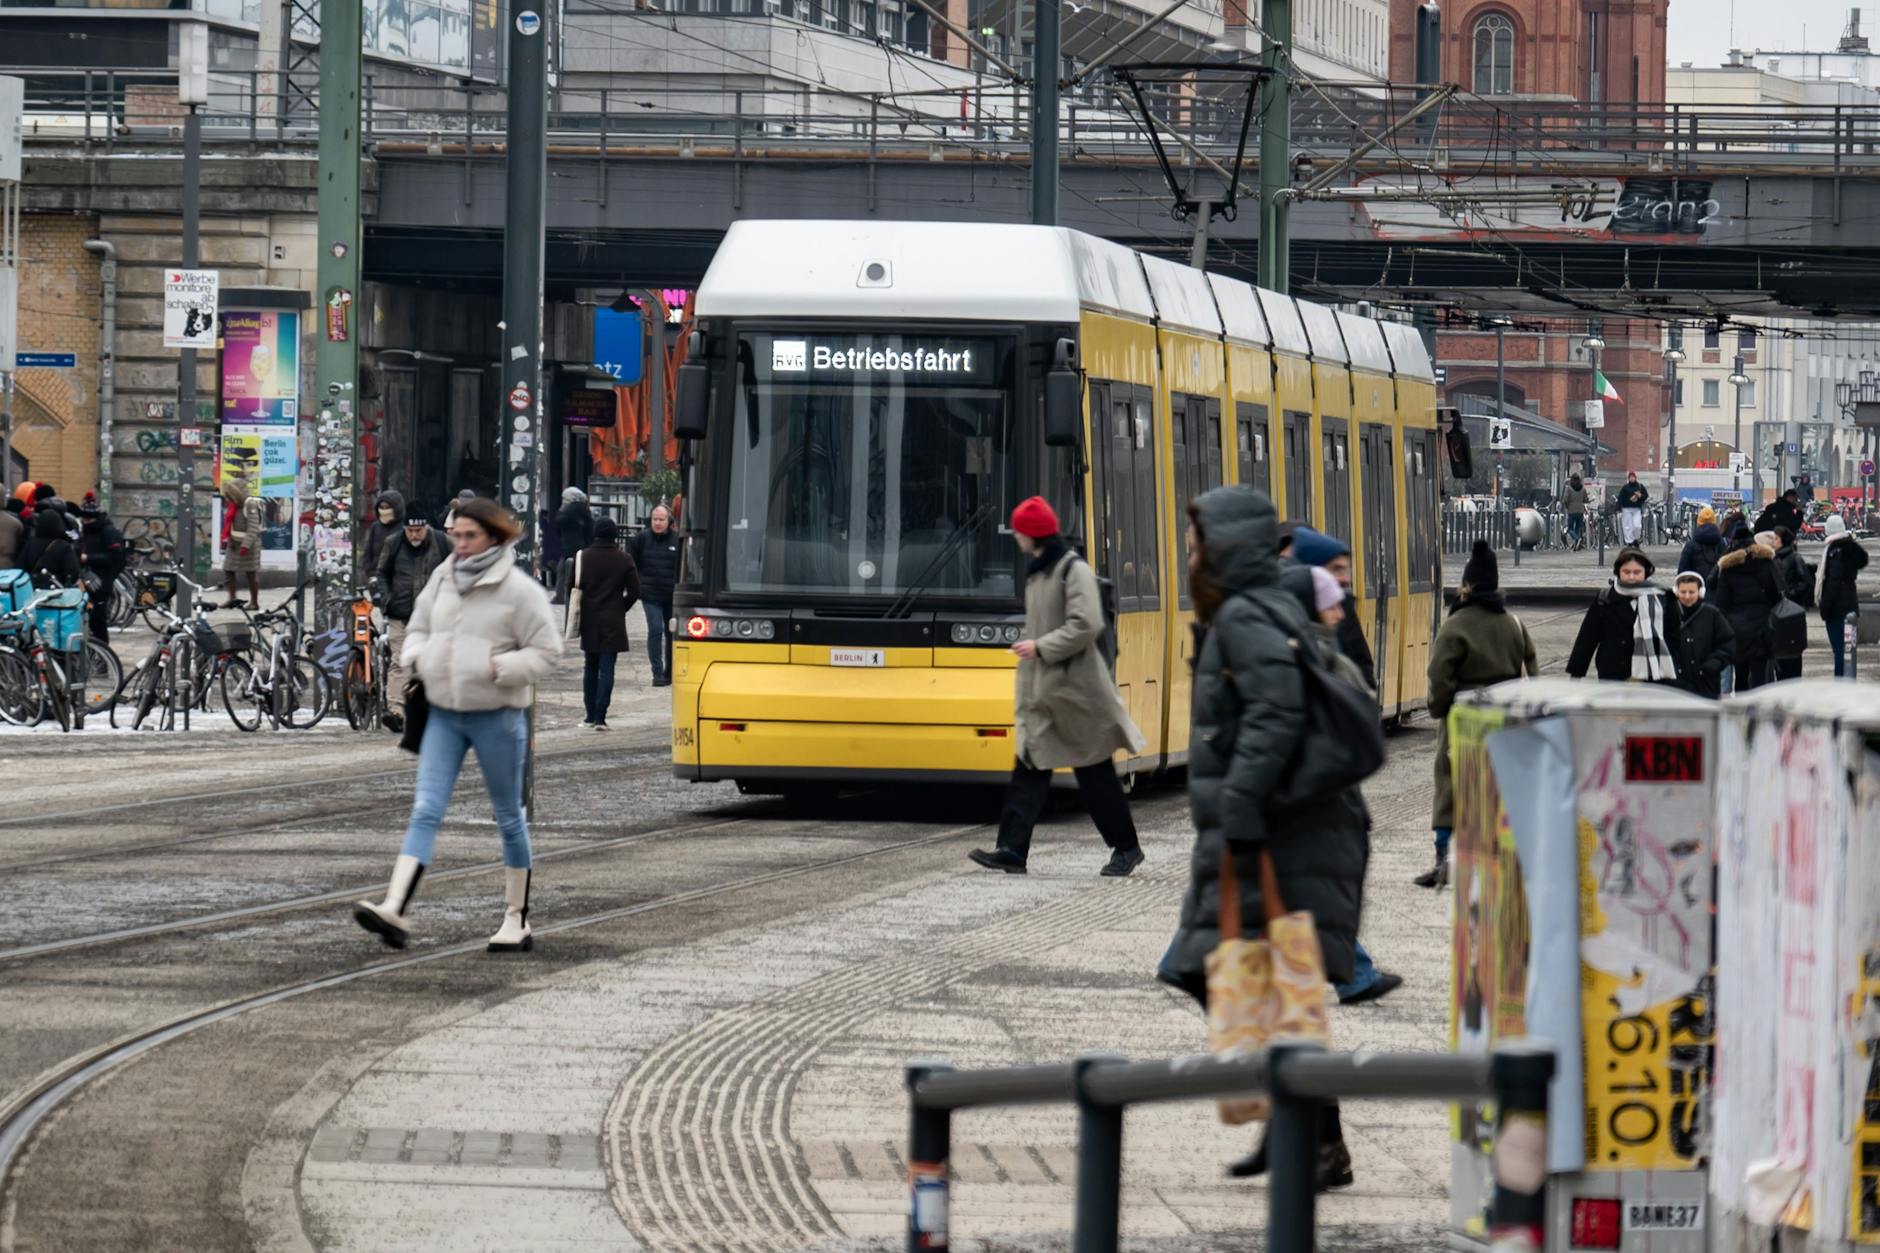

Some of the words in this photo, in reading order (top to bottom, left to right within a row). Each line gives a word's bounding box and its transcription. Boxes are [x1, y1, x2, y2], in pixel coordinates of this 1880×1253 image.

[182, 272, 215, 283] Werbe
[166, 283, 212, 293] monitore
[201, 293, 215, 303] ab
[814, 345, 972, 372] Betriebsfahrt
[834, 653, 864, 662] BERLIN
[1629, 739, 1699, 779] KBN
